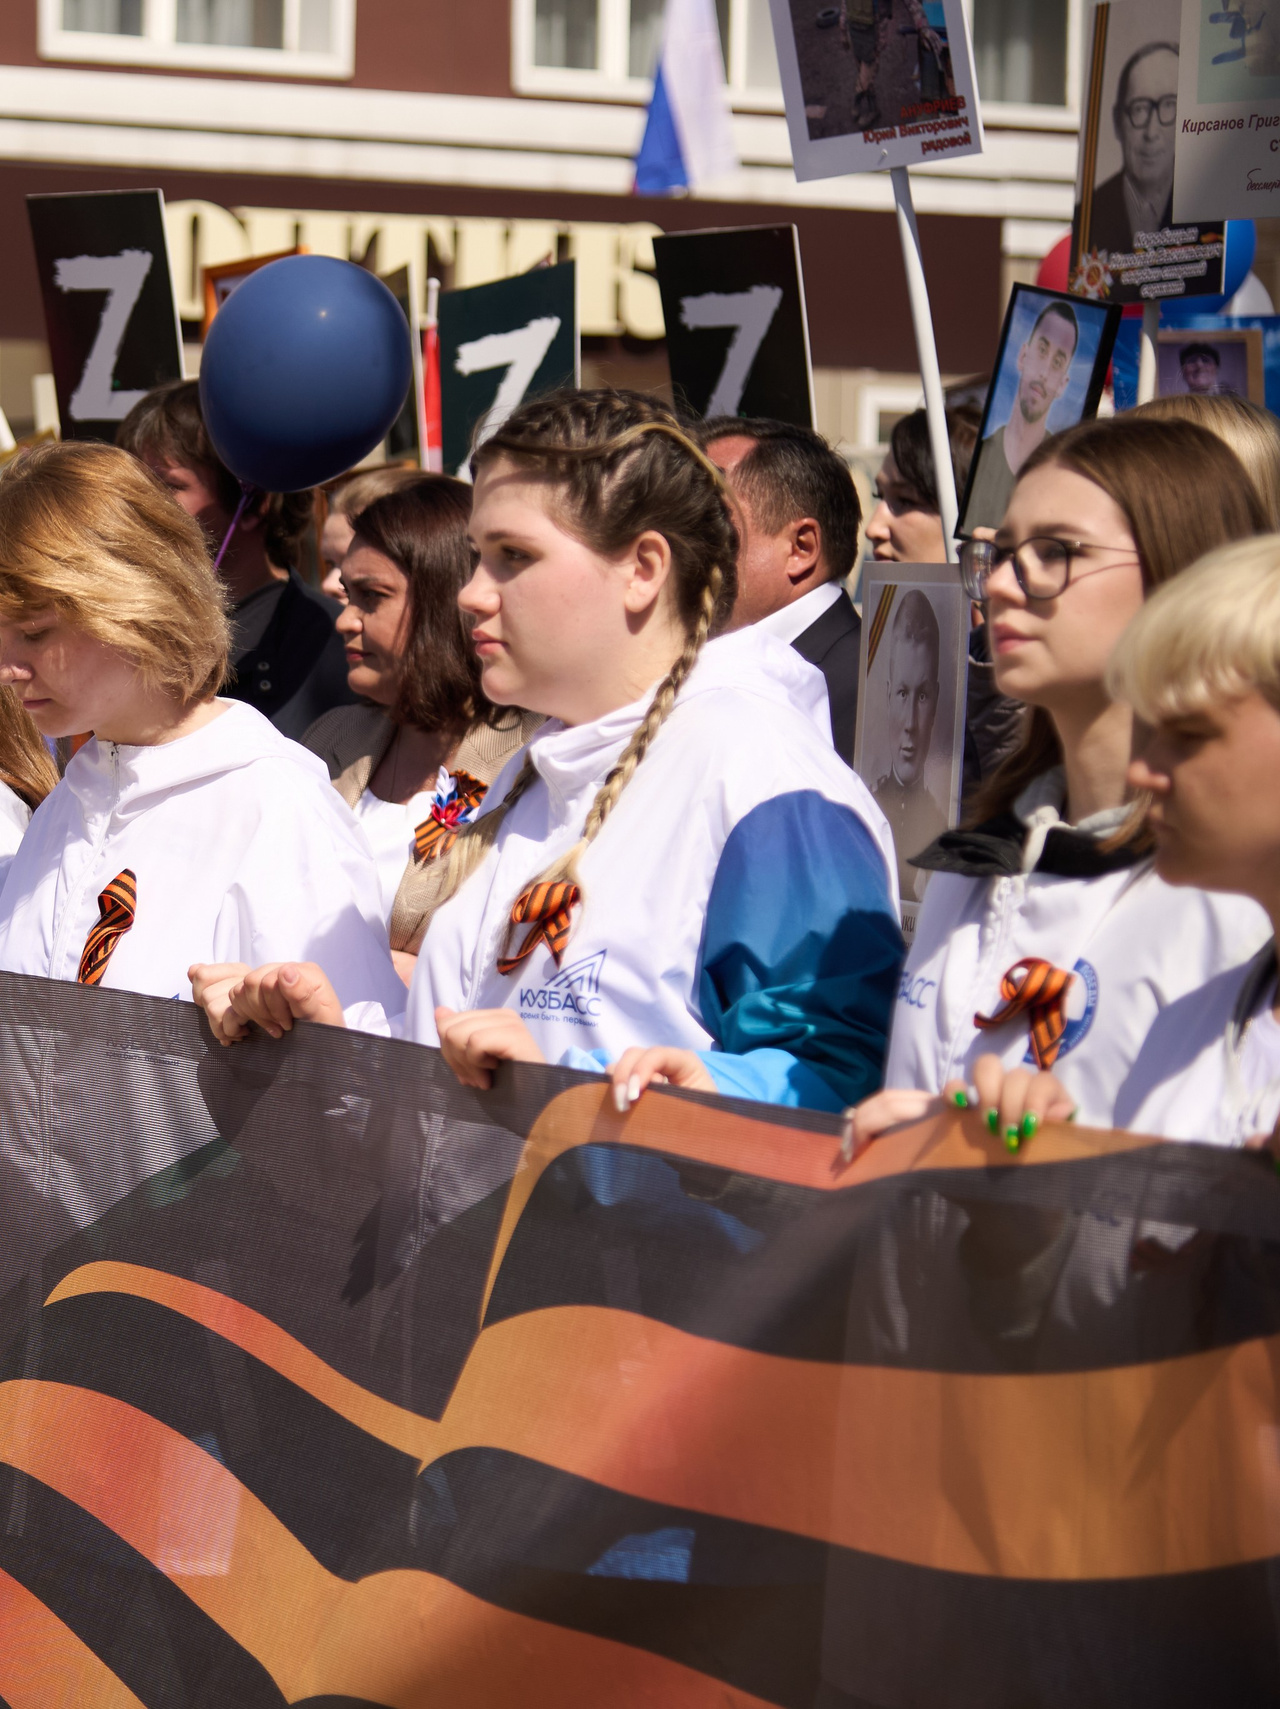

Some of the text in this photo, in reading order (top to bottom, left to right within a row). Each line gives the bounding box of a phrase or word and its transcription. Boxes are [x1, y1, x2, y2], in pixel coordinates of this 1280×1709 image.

[900, 95, 967, 118] АНУФРИЕВ
[863, 117, 969, 145] Юрий Викторович
[1182, 118, 1244, 136] Кирсанов
[921, 132, 972, 154] рядовой
[166, 199, 665, 340] ОТИК
[54, 248, 152, 421] Z
[520, 988, 602, 1016] КУЗБАСС
[541, 1011, 561, 1022] быть
